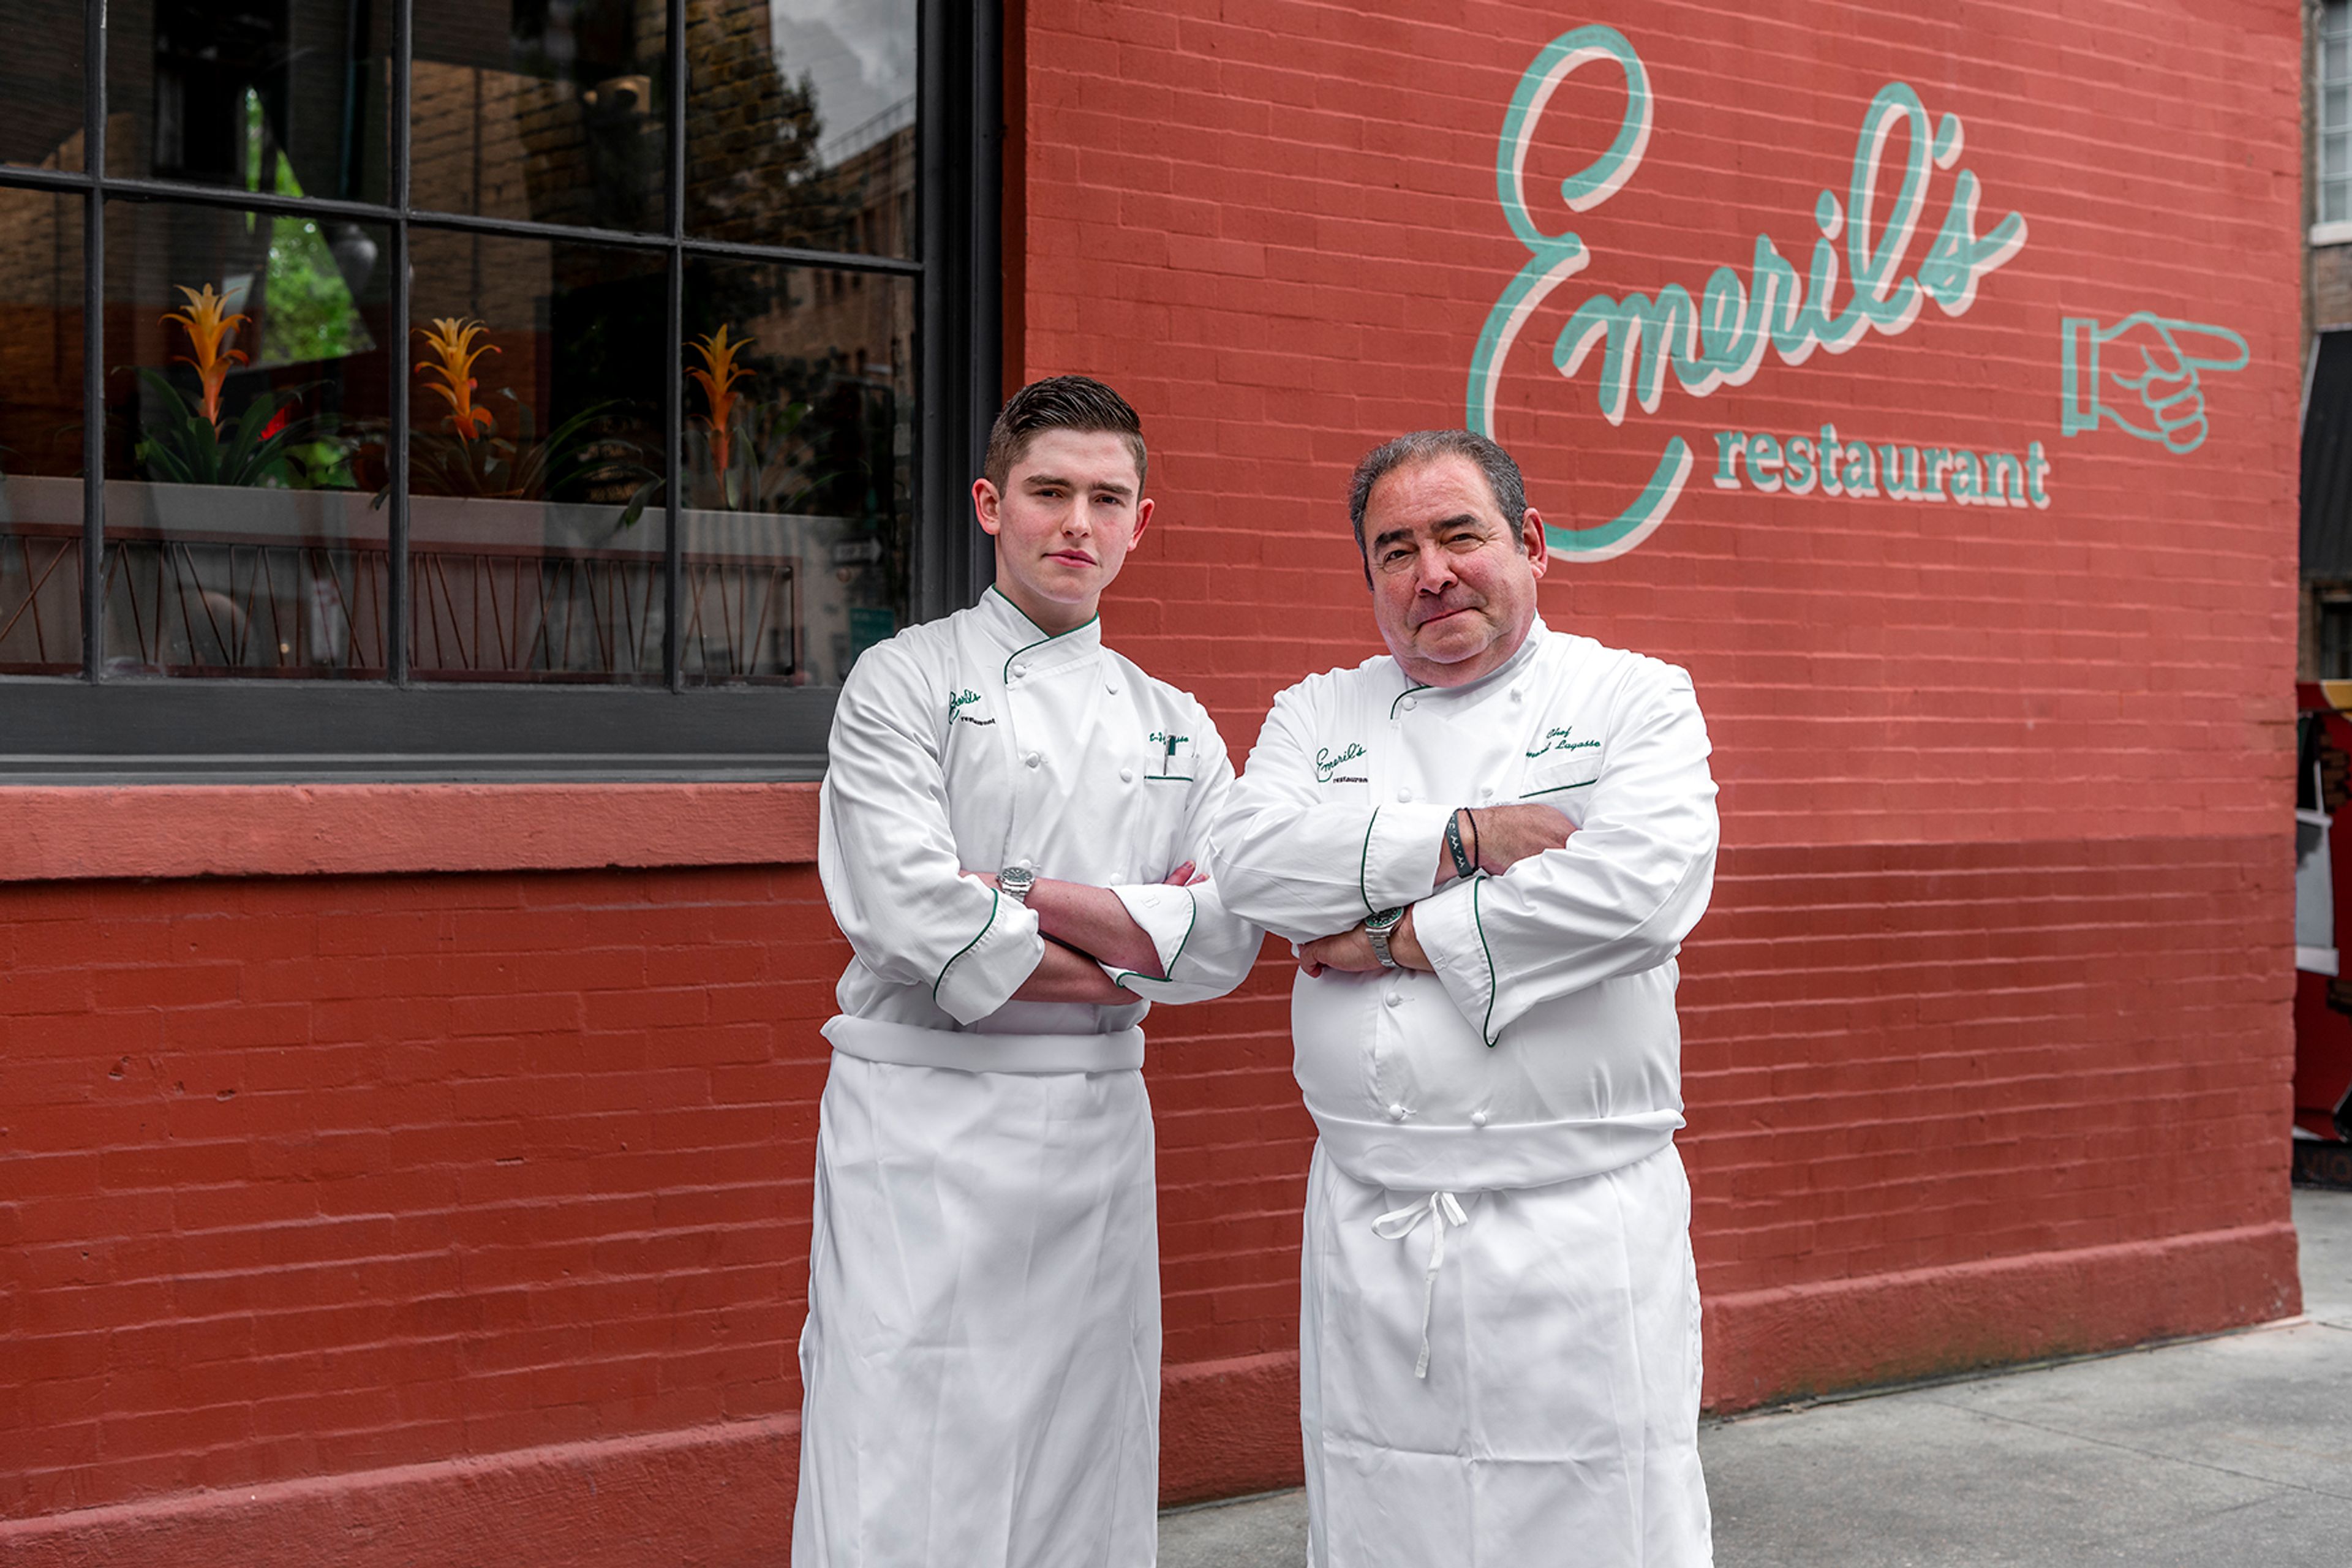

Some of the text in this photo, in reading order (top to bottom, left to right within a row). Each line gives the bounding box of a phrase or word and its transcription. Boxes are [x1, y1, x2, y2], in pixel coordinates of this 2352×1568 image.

[1466, 23, 2028, 562] Emeril's
[1713, 423, 2051, 509] restaurant
[1316, 742, 1367, 783] Emeril's
